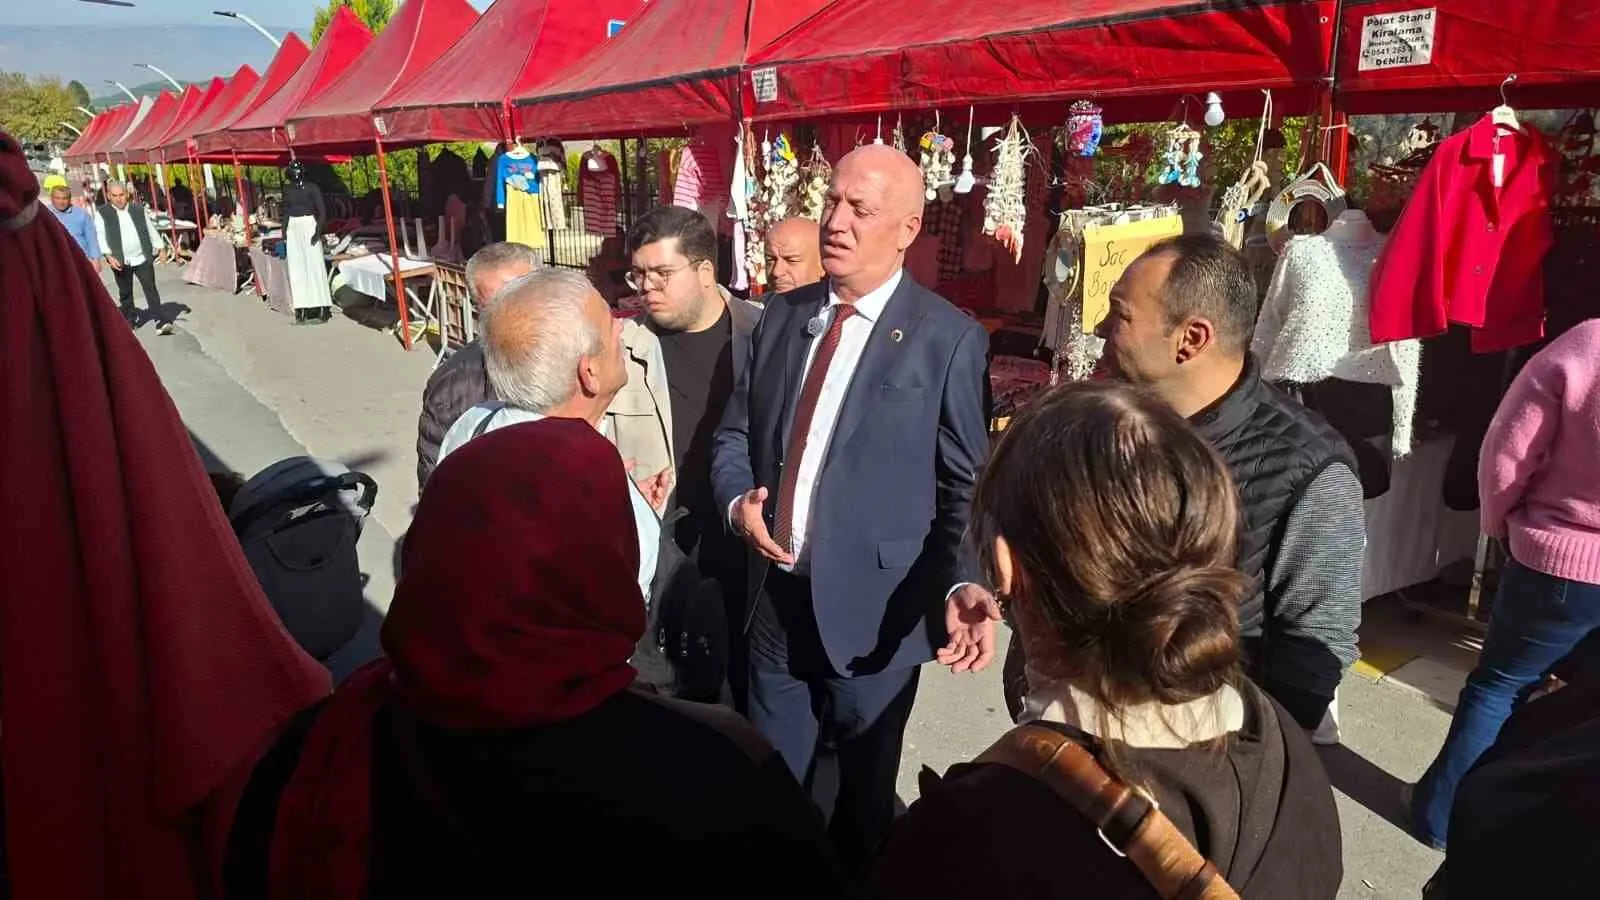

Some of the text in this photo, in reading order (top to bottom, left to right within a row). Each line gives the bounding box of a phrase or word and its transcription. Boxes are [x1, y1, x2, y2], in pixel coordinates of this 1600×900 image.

[1367, 11, 1431, 27] Polat Stand
[1372, 27, 1422, 38] Kiralama
